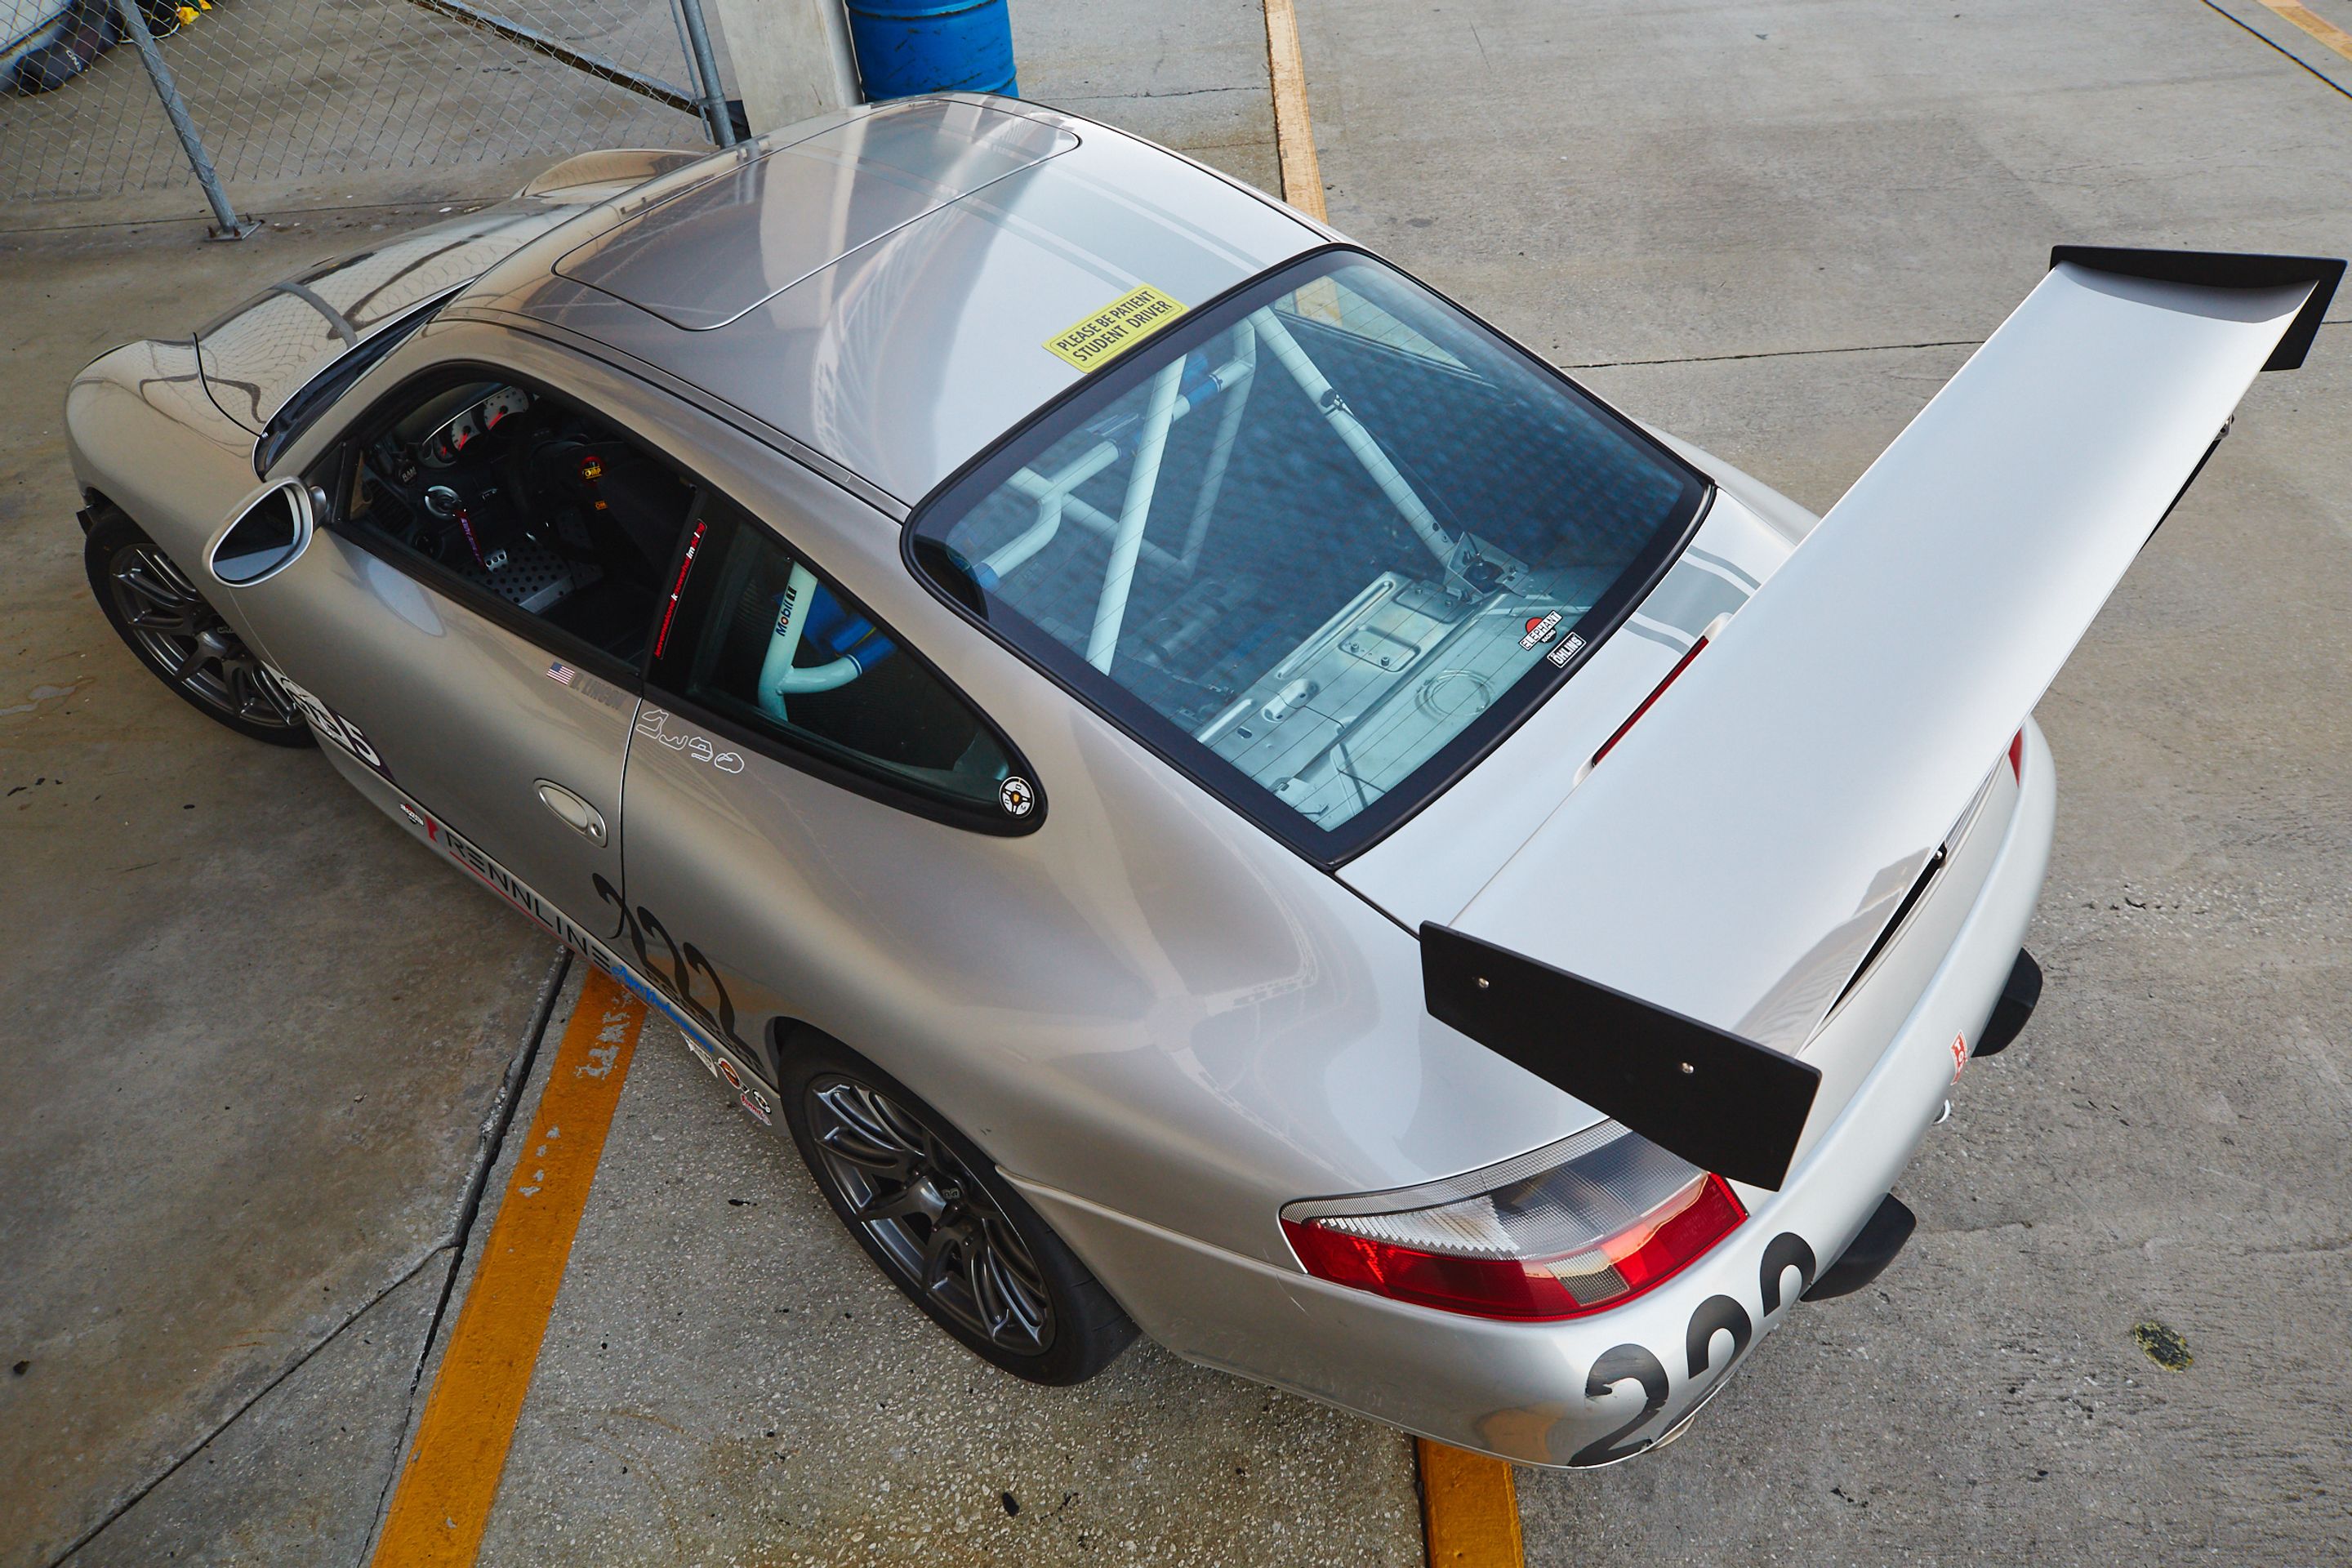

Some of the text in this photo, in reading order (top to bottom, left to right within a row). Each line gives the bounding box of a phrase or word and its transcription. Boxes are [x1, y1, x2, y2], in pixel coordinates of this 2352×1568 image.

[1056, 290, 1156, 351] PLEASE BE PATIENT
[1072, 300, 1173, 362] STUDENT DRIVER
[776, 599, 794, 637] Mobil
[1521, 612, 1561, 648] ELEPHANT
[444, 830, 612, 975] RENNLINE
[592, 872, 764, 1068] 222
